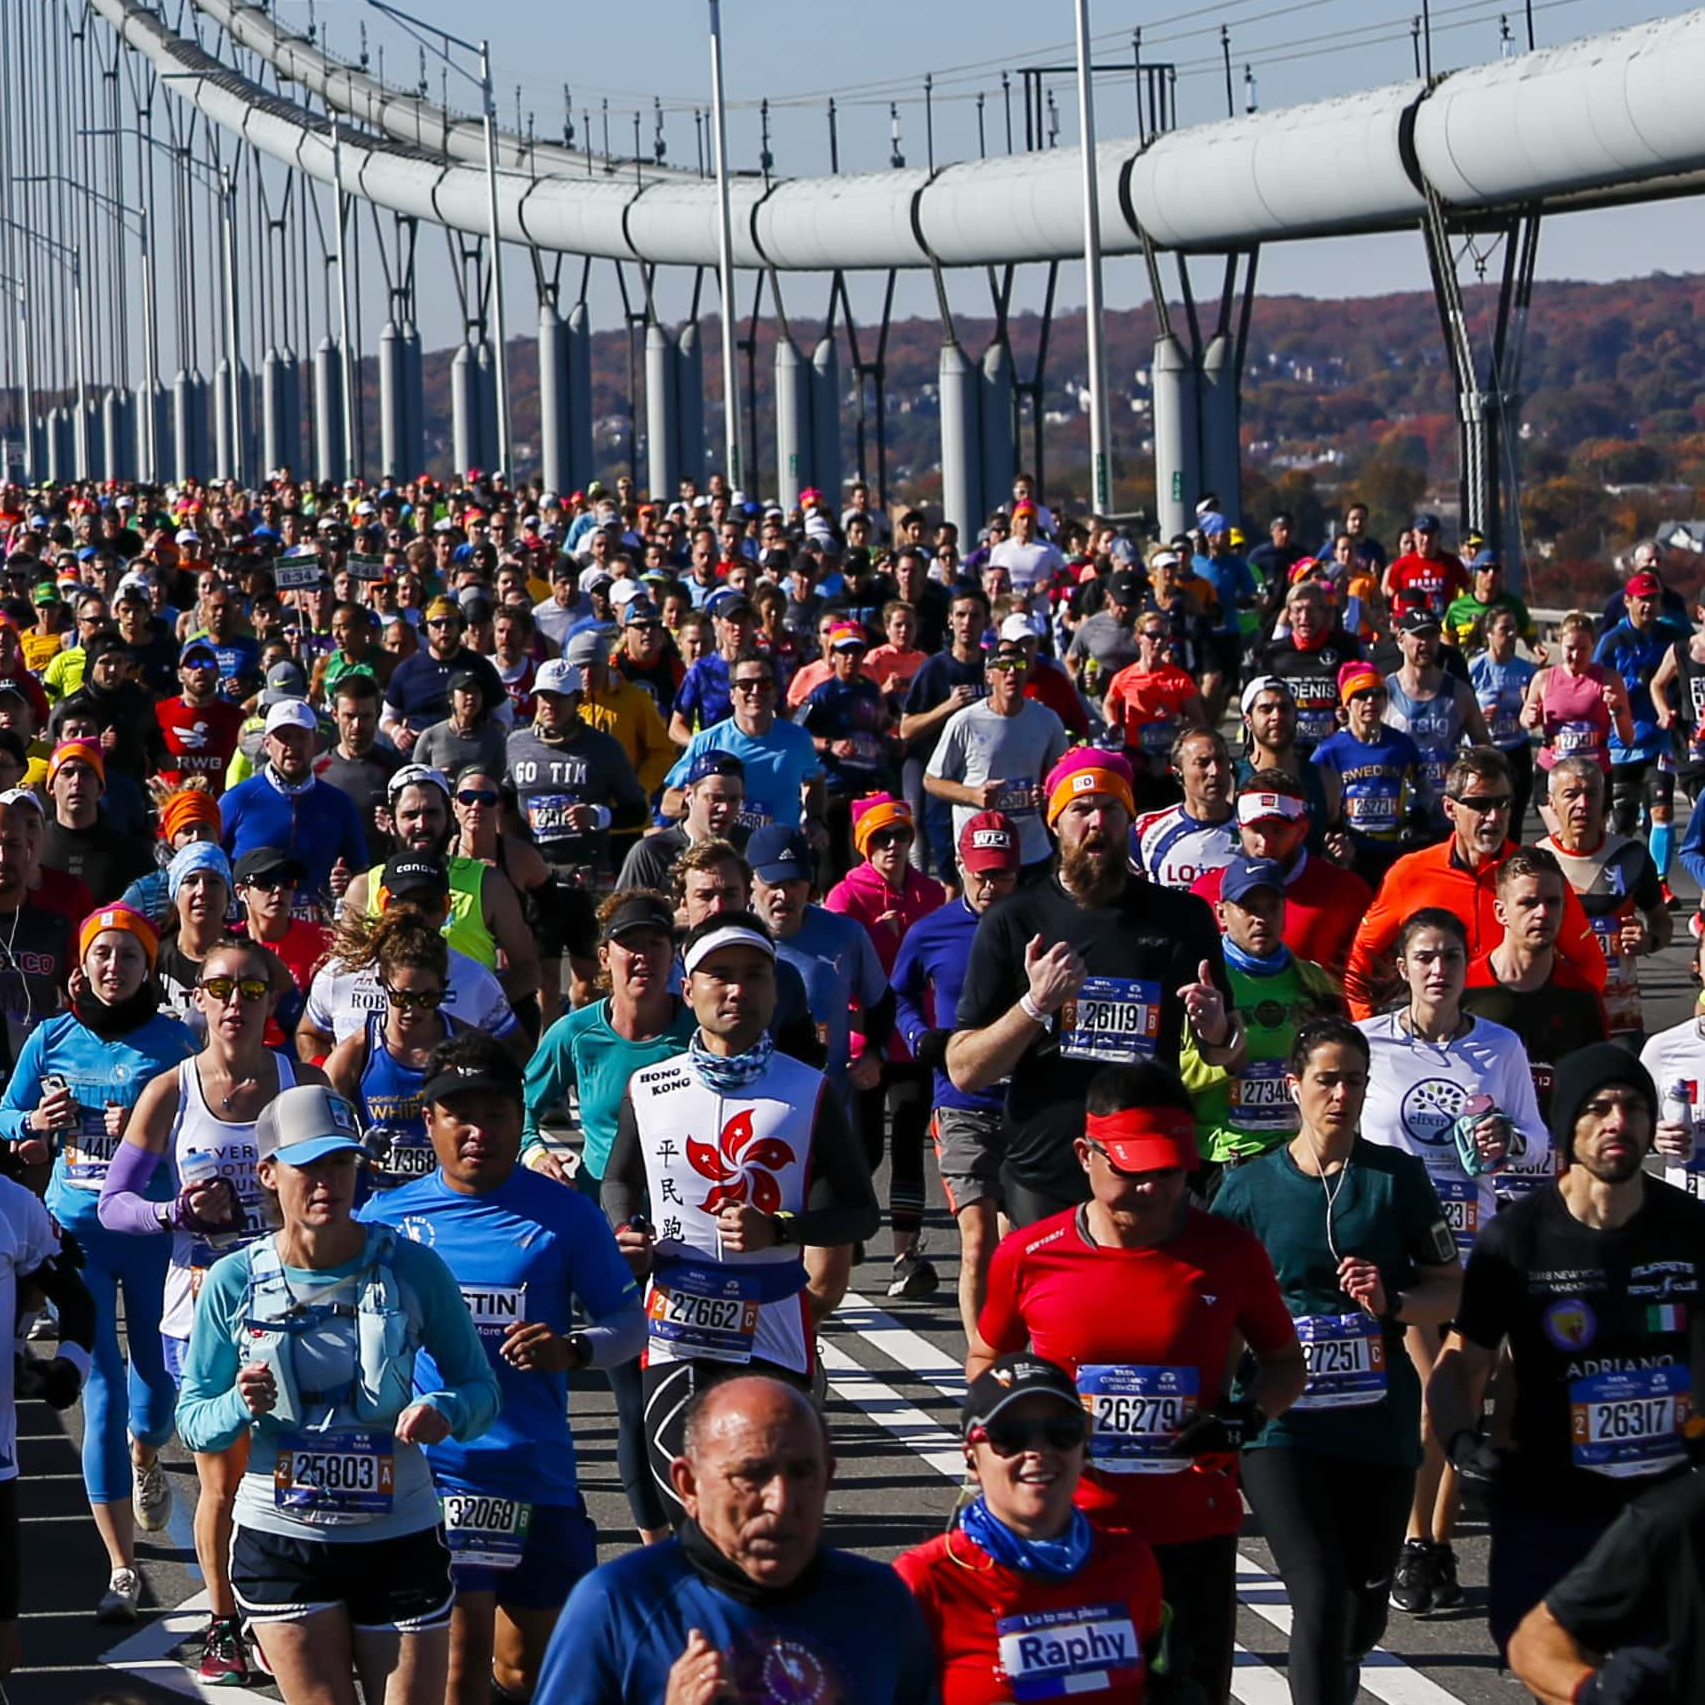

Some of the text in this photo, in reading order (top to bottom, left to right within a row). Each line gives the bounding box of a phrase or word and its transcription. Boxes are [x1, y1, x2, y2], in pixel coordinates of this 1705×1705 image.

[1289, 684, 1336, 699] DENIS
[515, 761, 538, 784] GO
[1341, 764, 1402, 784] SWEDEN
[973, 831, 1010, 848] WPI
[1084, 1002, 1139, 1033] 26119
[639, 1067, 681, 1084] HONG
[650, 1077, 691, 1096] KONG
[1408, 1112, 1449, 1128] elixir
[655, 1139, 687, 1244] 平民跑
[654, 1292, 755, 1330] 2 27662 C
[1372, 1344, 1381, 1363] C
[1098, 1396, 1179, 1434] 26279
[1574, 1414, 1585, 1436] 2
[1597, 1399, 1668, 1441] 26317
[279, 1453, 392, 1491] 2 25803 A
[449, 1496, 516, 1531] 32068
[1018, 1625, 1128, 1671] Raphy
